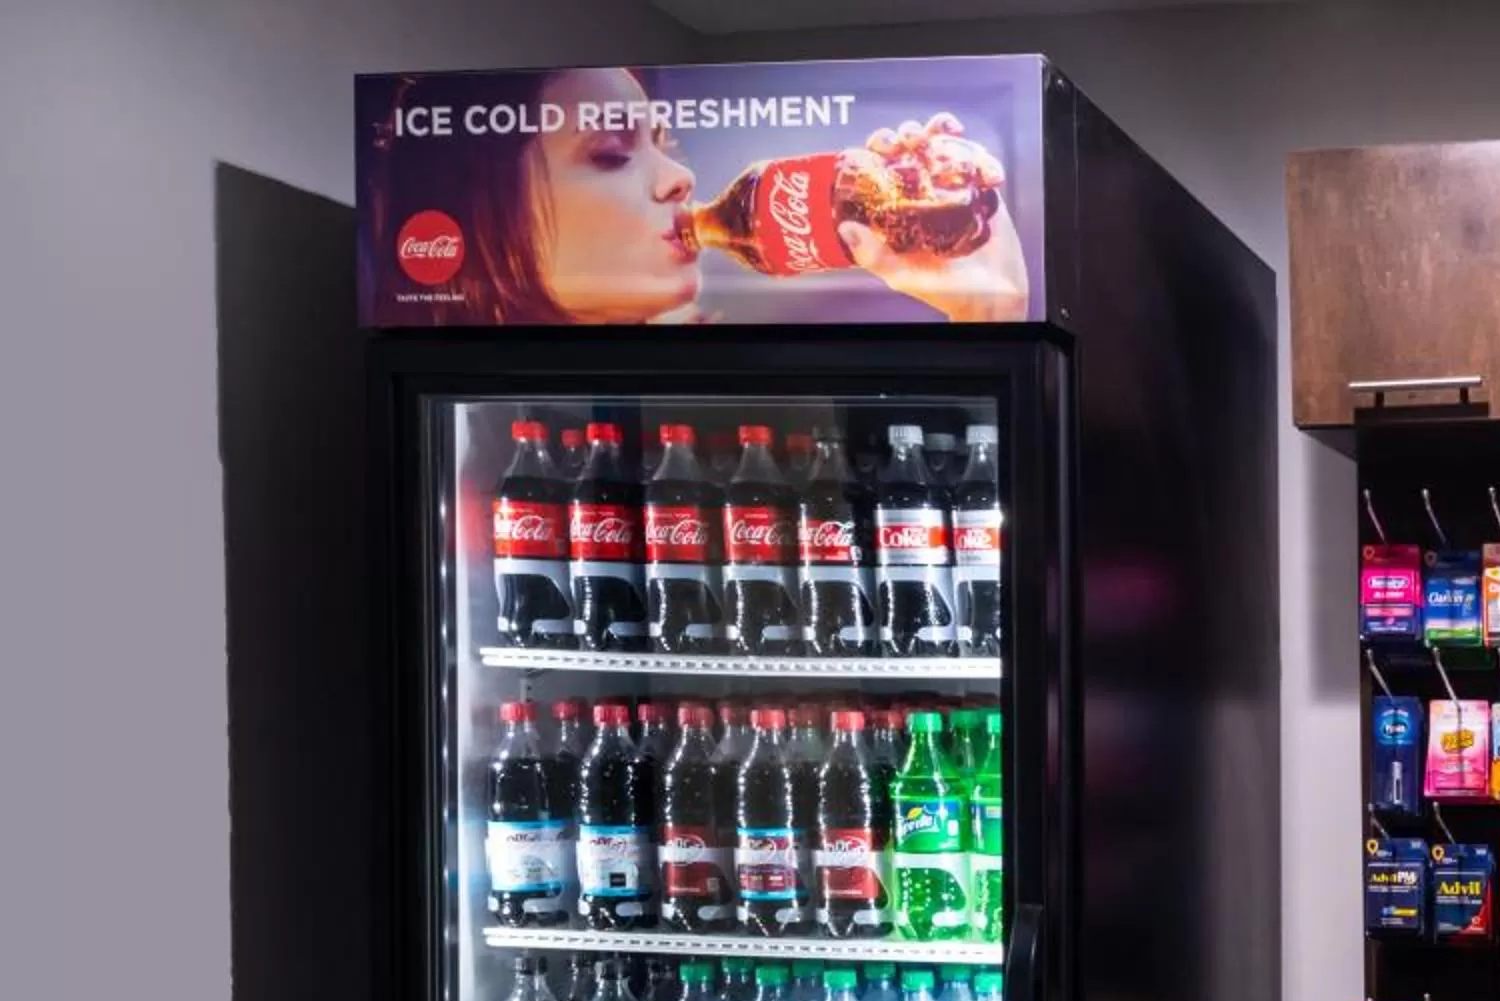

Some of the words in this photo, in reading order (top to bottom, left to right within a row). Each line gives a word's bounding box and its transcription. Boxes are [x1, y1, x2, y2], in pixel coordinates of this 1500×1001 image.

[395, 106, 453, 137] ICE
[464, 103, 566, 135] COLD
[577, 95, 856, 131] REFRESHMENT
[1437, 881, 1481, 896] Advil
